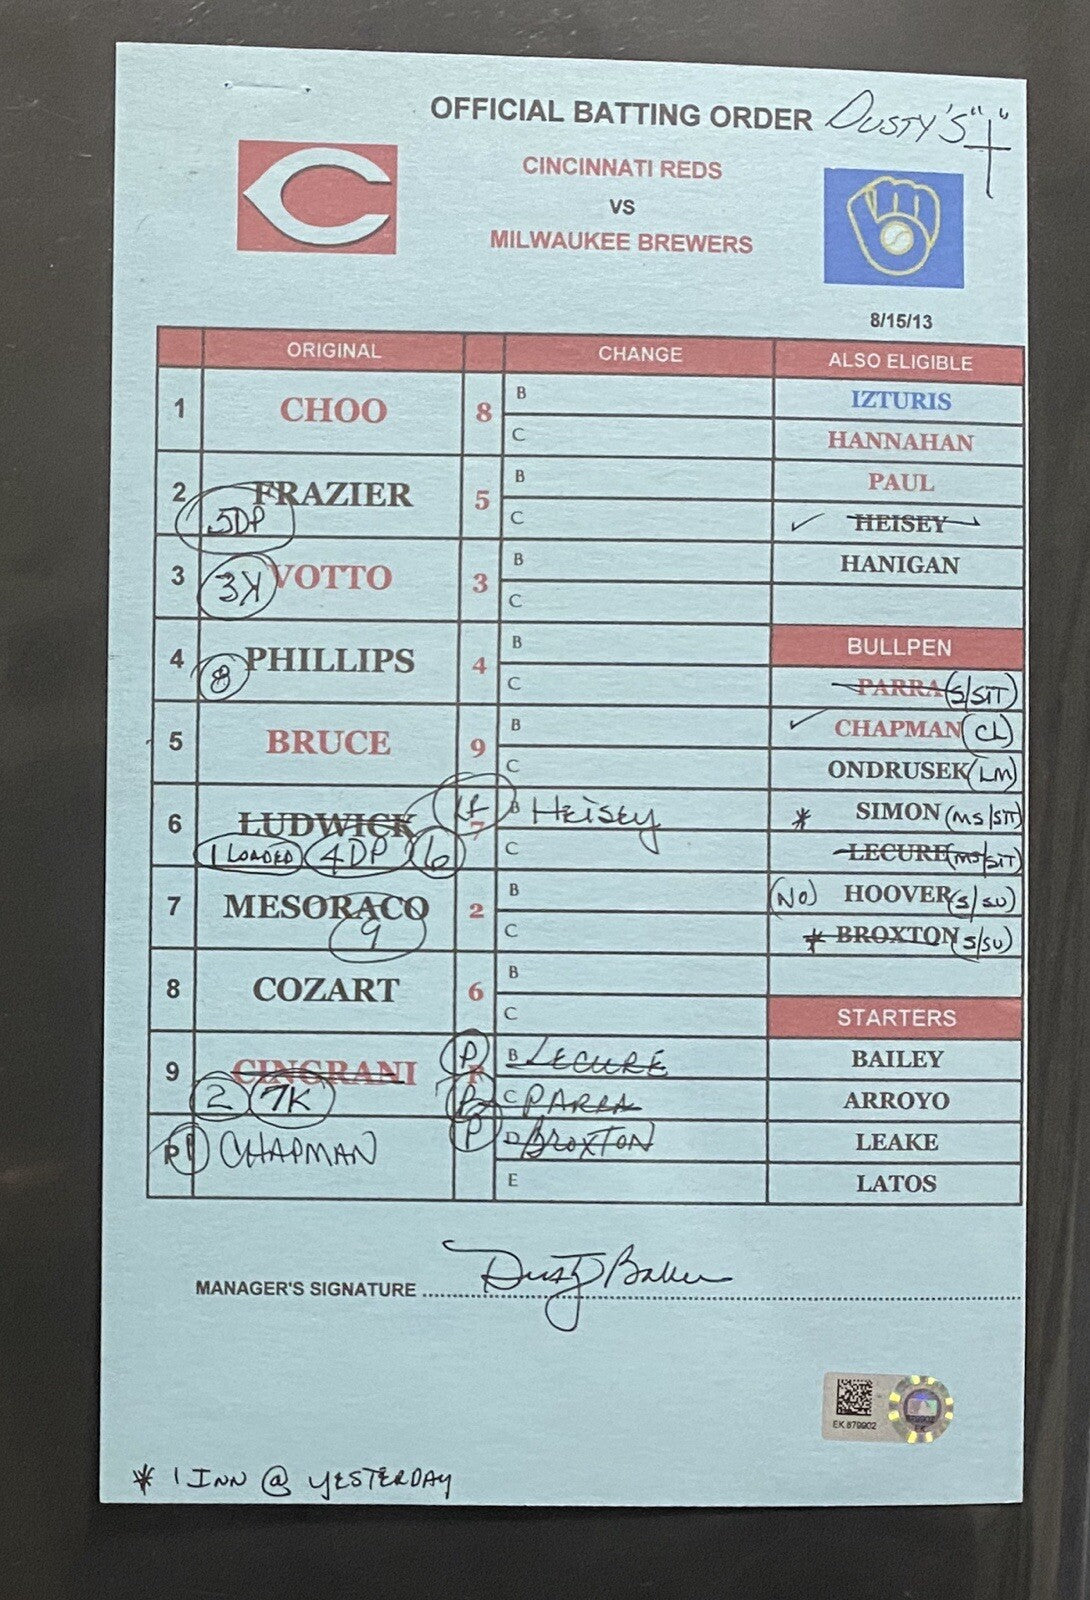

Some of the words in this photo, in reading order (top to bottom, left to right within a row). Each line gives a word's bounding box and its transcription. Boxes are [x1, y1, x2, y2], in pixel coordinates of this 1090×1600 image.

[430, 95, 565, 124] OFFICIAL
[574, 100, 701, 127] BATTING
[710, 105, 814, 132] ORDER
[522, 156, 653, 178] CINCINNATI
[660, 159, 723, 180] REDS
[609, 199, 636, 215] VS
[490, 229, 632, 251] MILWAUKEE
[638, 233, 754, 254] BREWERS
[869, 312, 933, 330] 8/15/13
[287, 341, 382, 360] ORIGINAL
[598, 346, 683, 364] CHANGE
[828, 352, 881, 370] ALSO
[887, 354, 973, 372] ELIGIBLE
[516, 386, 526, 400] B
[850, 390, 952, 411] IZTURIS
[174, 398, 184, 418] 1
[280, 397, 387, 423] CHOO
[476, 402, 492, 422] 8
[512, 427, 526, 442] C
[827, 431, 975, 452] HANNAHAN
[515, 469, 525, 483] B
[867, 472, 935, 492] PAUL
[172, 482, 186, 502] 2
[252, 481, 414, 507] FRAZIER
[474, 489, 490, 510] 5
[510, 511, 524, 525] C
[854, 513, 949, 533] HEISEY
[514, 553, 524, 566] B
[840, 554, 961, 575] HANIGAN
[171, 565, 185, 586] 3
[266, 564, 393, 591] VOTTO
[472, 573, 488, 594] 3
[508, 594, 523, 608] C
[512, 636, 522, 649] B
[847, 637, 952, 657] BULLPEN
[169, 648, 184, 669] 4
[244, 647, 415, 674] PHILLIPS
[472, 656, 487, 675] 4
[507, 677, 522, 691] C
[856, 678, 944, 697] PARRA
[511, 718, 521, 731] B
[834, 719, 962, 738] CHAPMAN
[169, 731, 183, 752] 5
[266, 729, 391, 755] BRUCE
[470, 738, 486, 758] 9
[506, 759, 520, 773] C
[827, 760, 970, 780] ONDRUSEK
[509, 800, 520, 814] B
[856, 802, 942, 821] SIMON
[168, 813, 182, 833] 6
[238, 811, 418, 838] LUDWICK
[505, 841, 519, 855] C
[848, 843, 950, 862] LECURE
[508, 883, 519, 897] B
[844, 884, 952, 903] HOOVER
[166, 896, 181, 916] 7
[223, 893, 430, 921] MESORACO
[469, 902, 485, 919] 2
[504, 923, 519, 938] C
[836, 925, 960, 945] BROXTON
[508, 965, 519, 979] B
[166, 978, 180, 998] 8
[253, 976, 401, 1003] COZART
[468, 981, 484, 1002] 6
[503, 1006, 518, 1021] C
[837, 1008, 958, 1028] STARTERS
[508, 1048, 518, 1062] B
[851, 1050, 945, 1069] BAILEY
[165, 1061, 179, 1081] 9
[230, 1059, 418, 1086] CINGRANI
[503, 1089, 516, 1104] C
[843, 1091, 951, 1110] ARROYO
[855, 1133, 939, 1151] LEAKE
[508, 1173, 518, 1187] E
[856, 1174, 938, 1193] LATOS
[196, 1279, 304, 1297] MANAGER'S
[310, 1281, 417, 1298] SIGNATURE
[832, 1420, 844, 1429] EK
